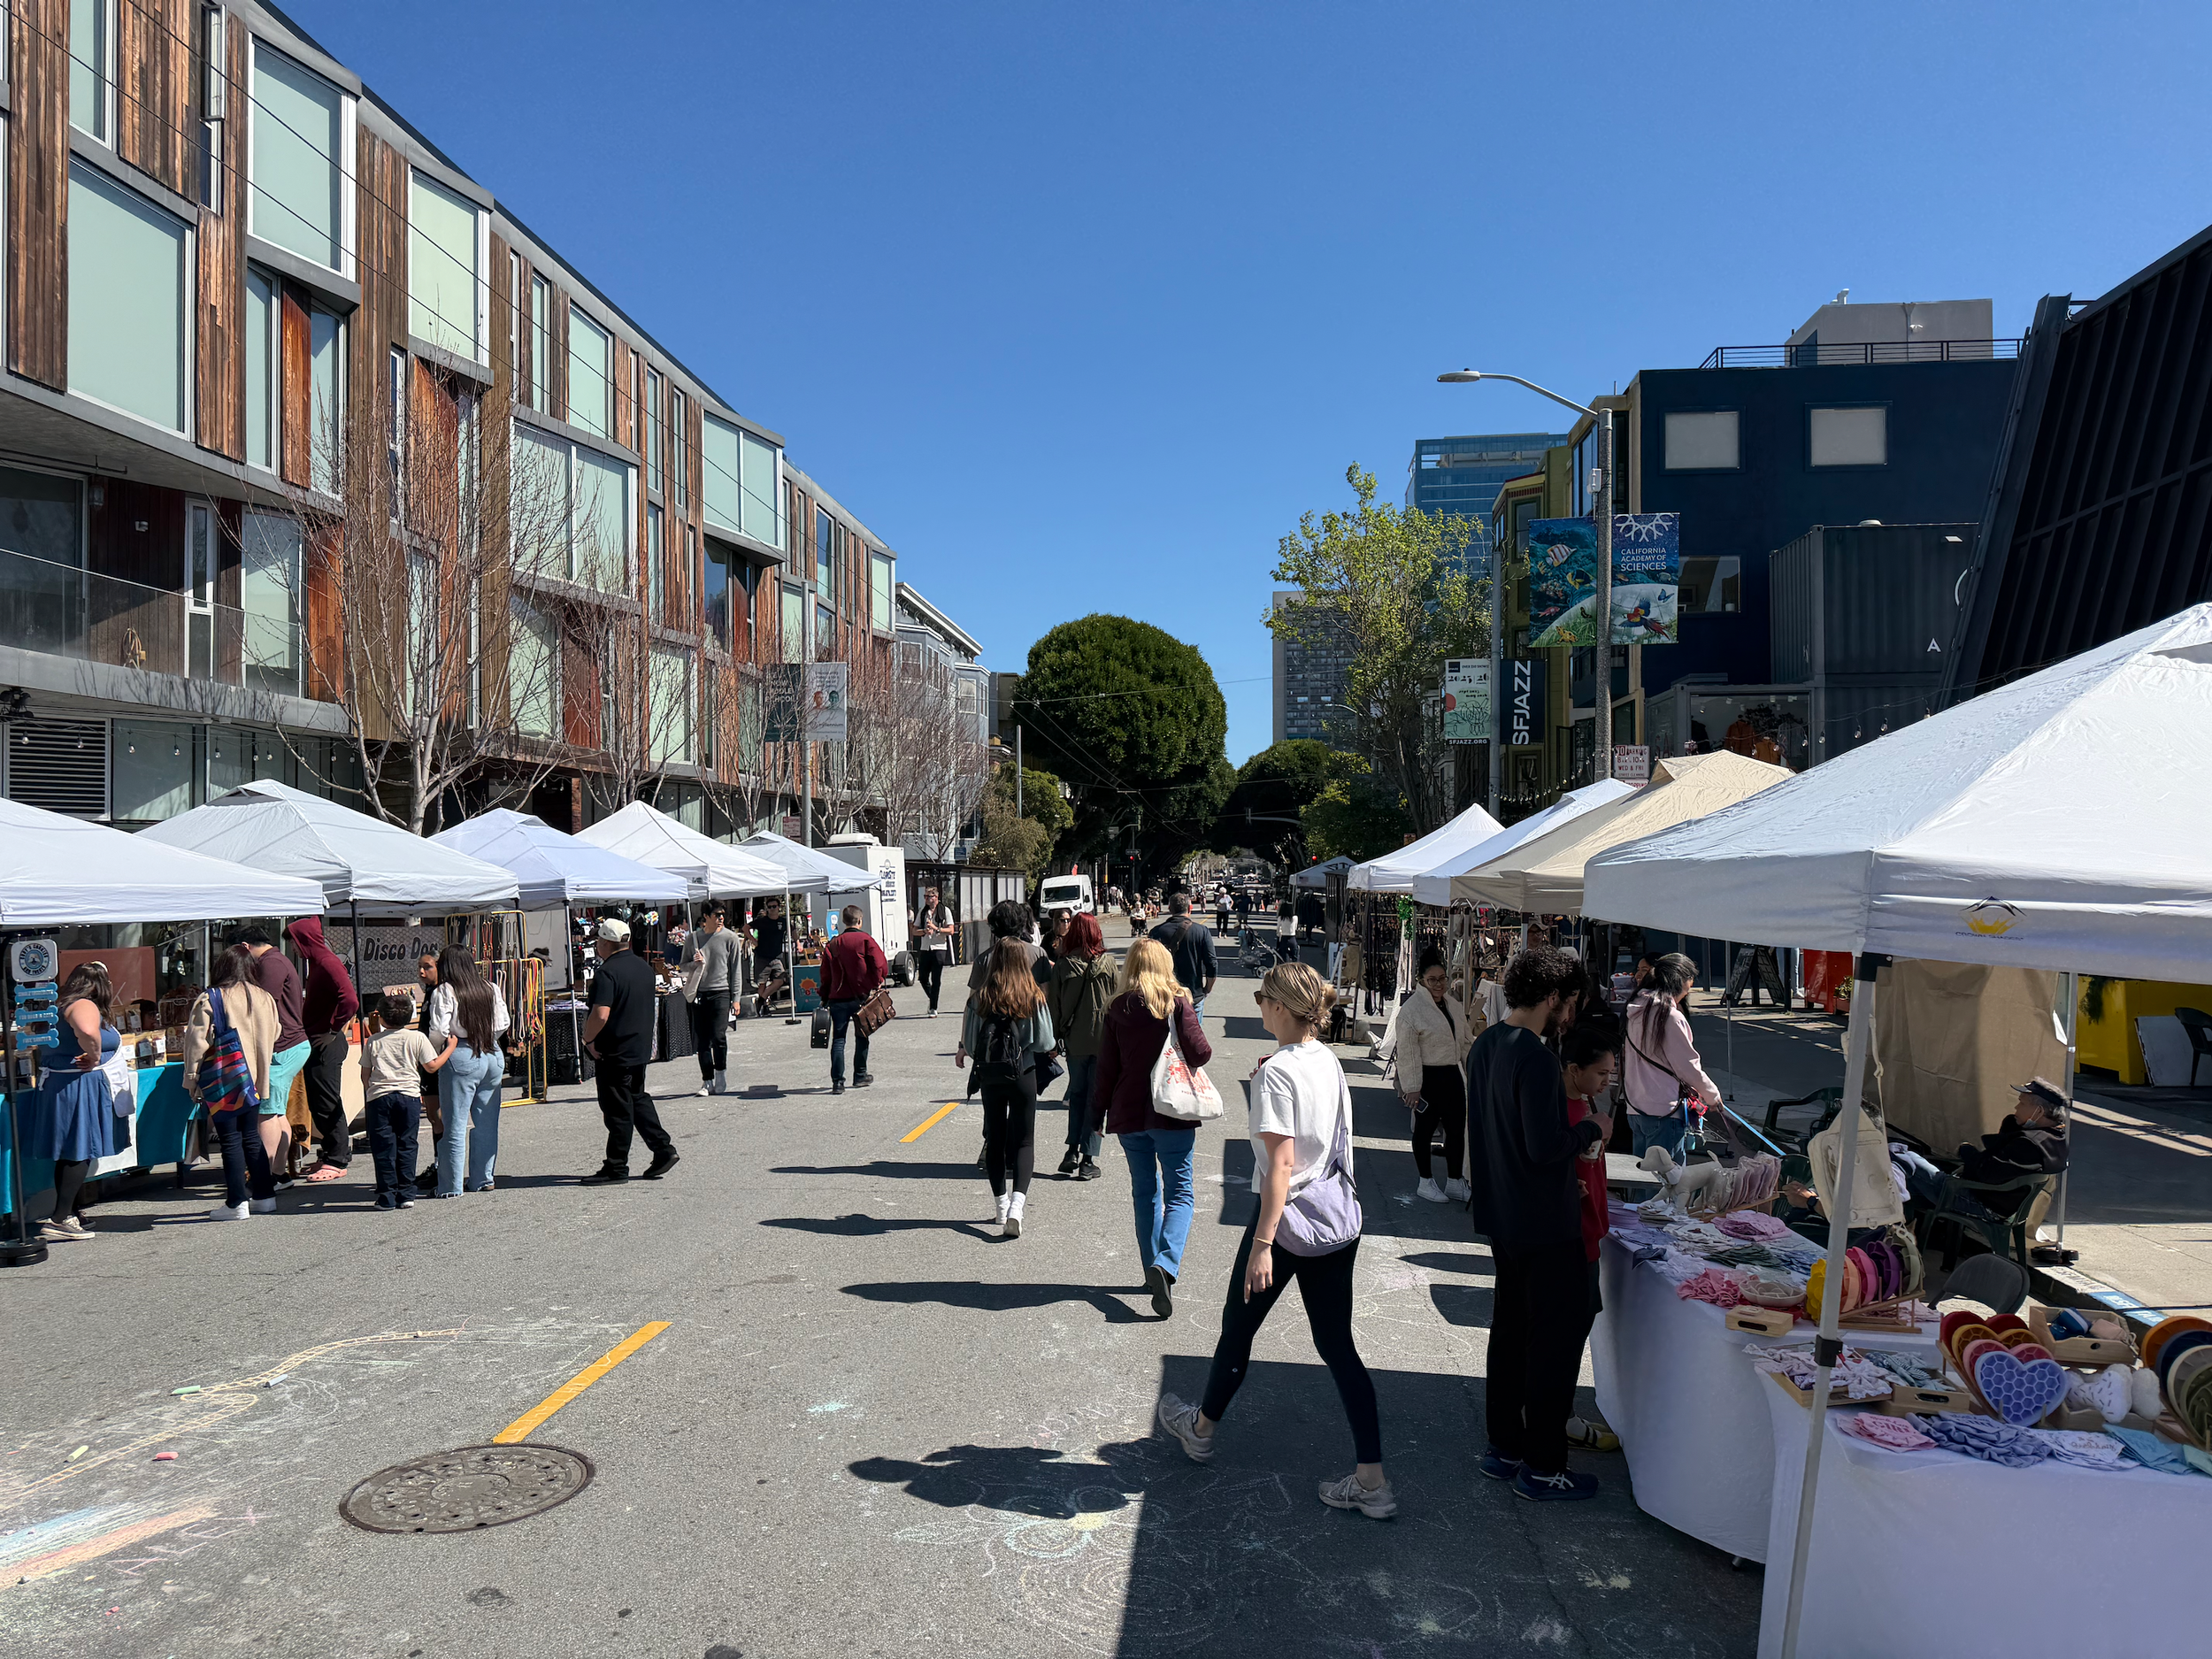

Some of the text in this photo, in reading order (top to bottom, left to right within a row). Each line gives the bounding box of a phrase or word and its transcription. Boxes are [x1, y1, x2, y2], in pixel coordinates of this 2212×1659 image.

[1621, 562, 1667, 571] SCIENCES
[1512, 660, 1531, 744] SFJAZZ
[363, 937, 406, 961] Disco
